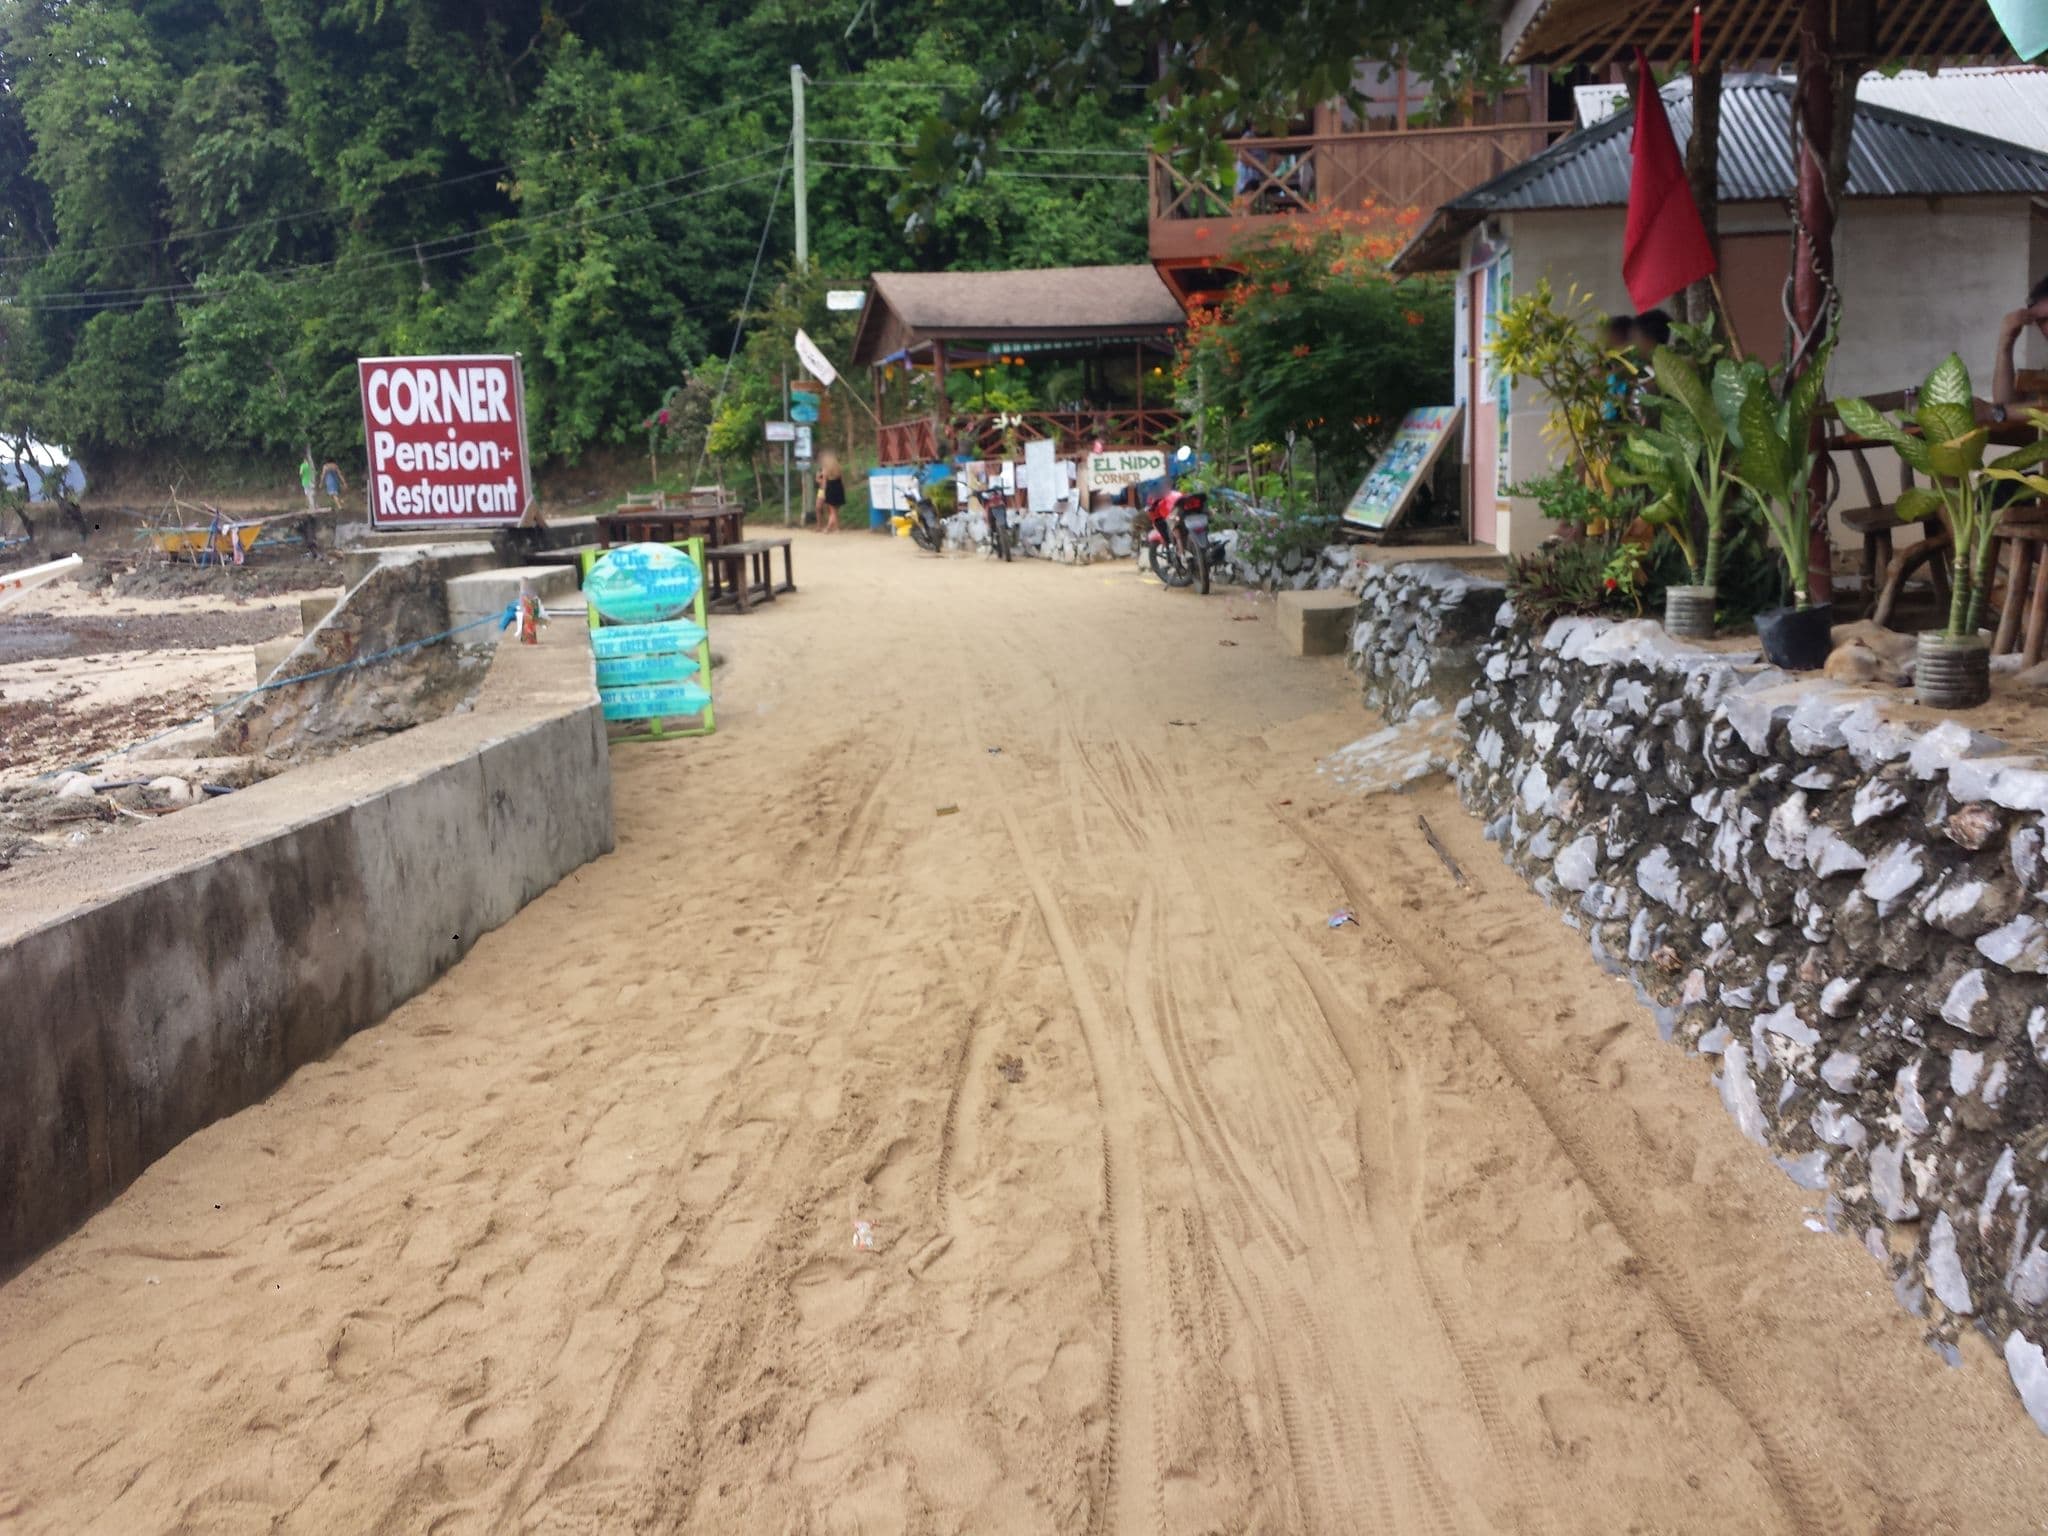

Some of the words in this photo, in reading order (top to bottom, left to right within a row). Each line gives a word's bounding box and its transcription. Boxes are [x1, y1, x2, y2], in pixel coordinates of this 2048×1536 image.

[368, 367, 512, 426] CORNER
[1094, 456, 1116, 472] EL
[1120, 455, 1160, 470] NIDO
[1094, 472, 1140, 485] CORNER
[377, 474, 517, 515] Restaurant
